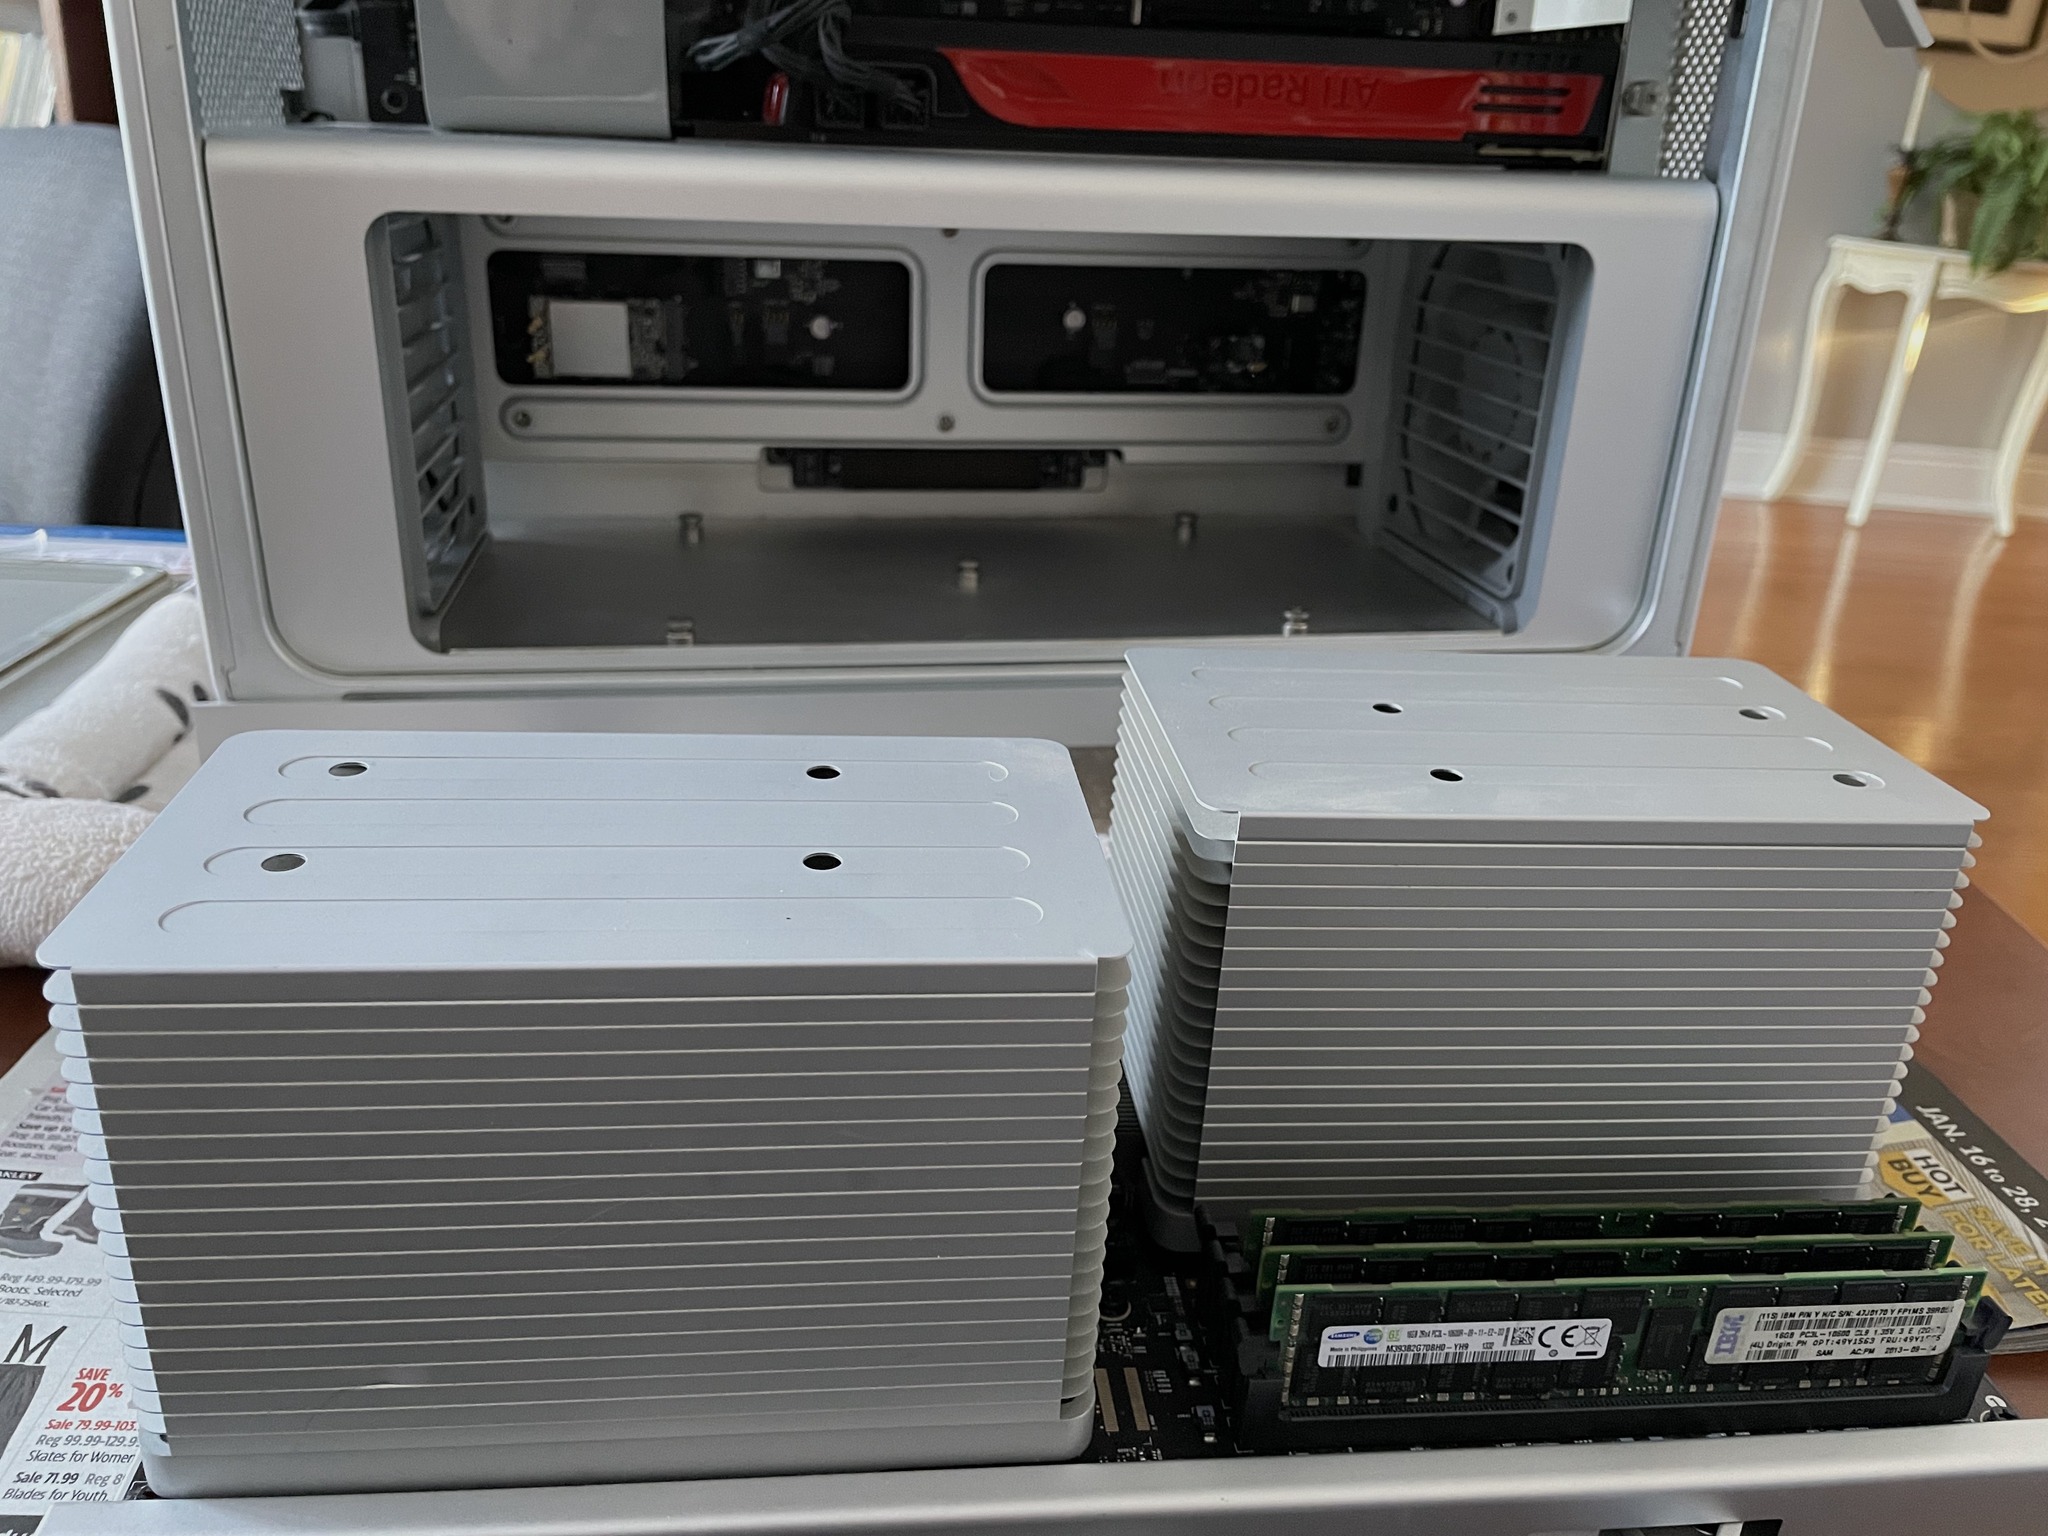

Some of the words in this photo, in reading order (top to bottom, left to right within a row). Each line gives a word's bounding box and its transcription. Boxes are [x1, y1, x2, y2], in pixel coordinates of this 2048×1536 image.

[1324, 76, 1382, 108] ATI
[1916, 1106, 1966, 1142] JAN.
[1959, 1145, 1996, 1166] 16
[1984, 1168, 2005, 1182] to
[2001, 1186, 2039, 1213] 28,
[1888, 1159, 1943, 1197] BUY
[1914, 1156, 1967, 1193] HOT
[1942, 1211, 1993, 1250] FOR
[1971, 1206, 2033, 1256] SAVE
[0, 1272, 22, 1283] Reg
[34, 1287, 83, 1297] Selected
[1714, 1315, 1745, 1355] IBM
[75, 1368, 112, 1380] SAVE
[56, 1382, 124, 1412] 20%
[45, 1418, 73, 1430] Sale
[35, 1434, 62, 1447] Reg
[63, 1435, 140, 1448] 99.99-129.9
[26, 1450, 68, 1461] Skates
[69, 1450, 89, 1463] for
[12, 1471, 43, 1483] Sale
[44, 1472, 80, 1484] 71.99
[84, 1473, 111, 1488] Reg
[112, 1473, 126, 1485] 8
[2, 1488, 47, 1500] Blades
[48, 1488, 69, 1500] for
